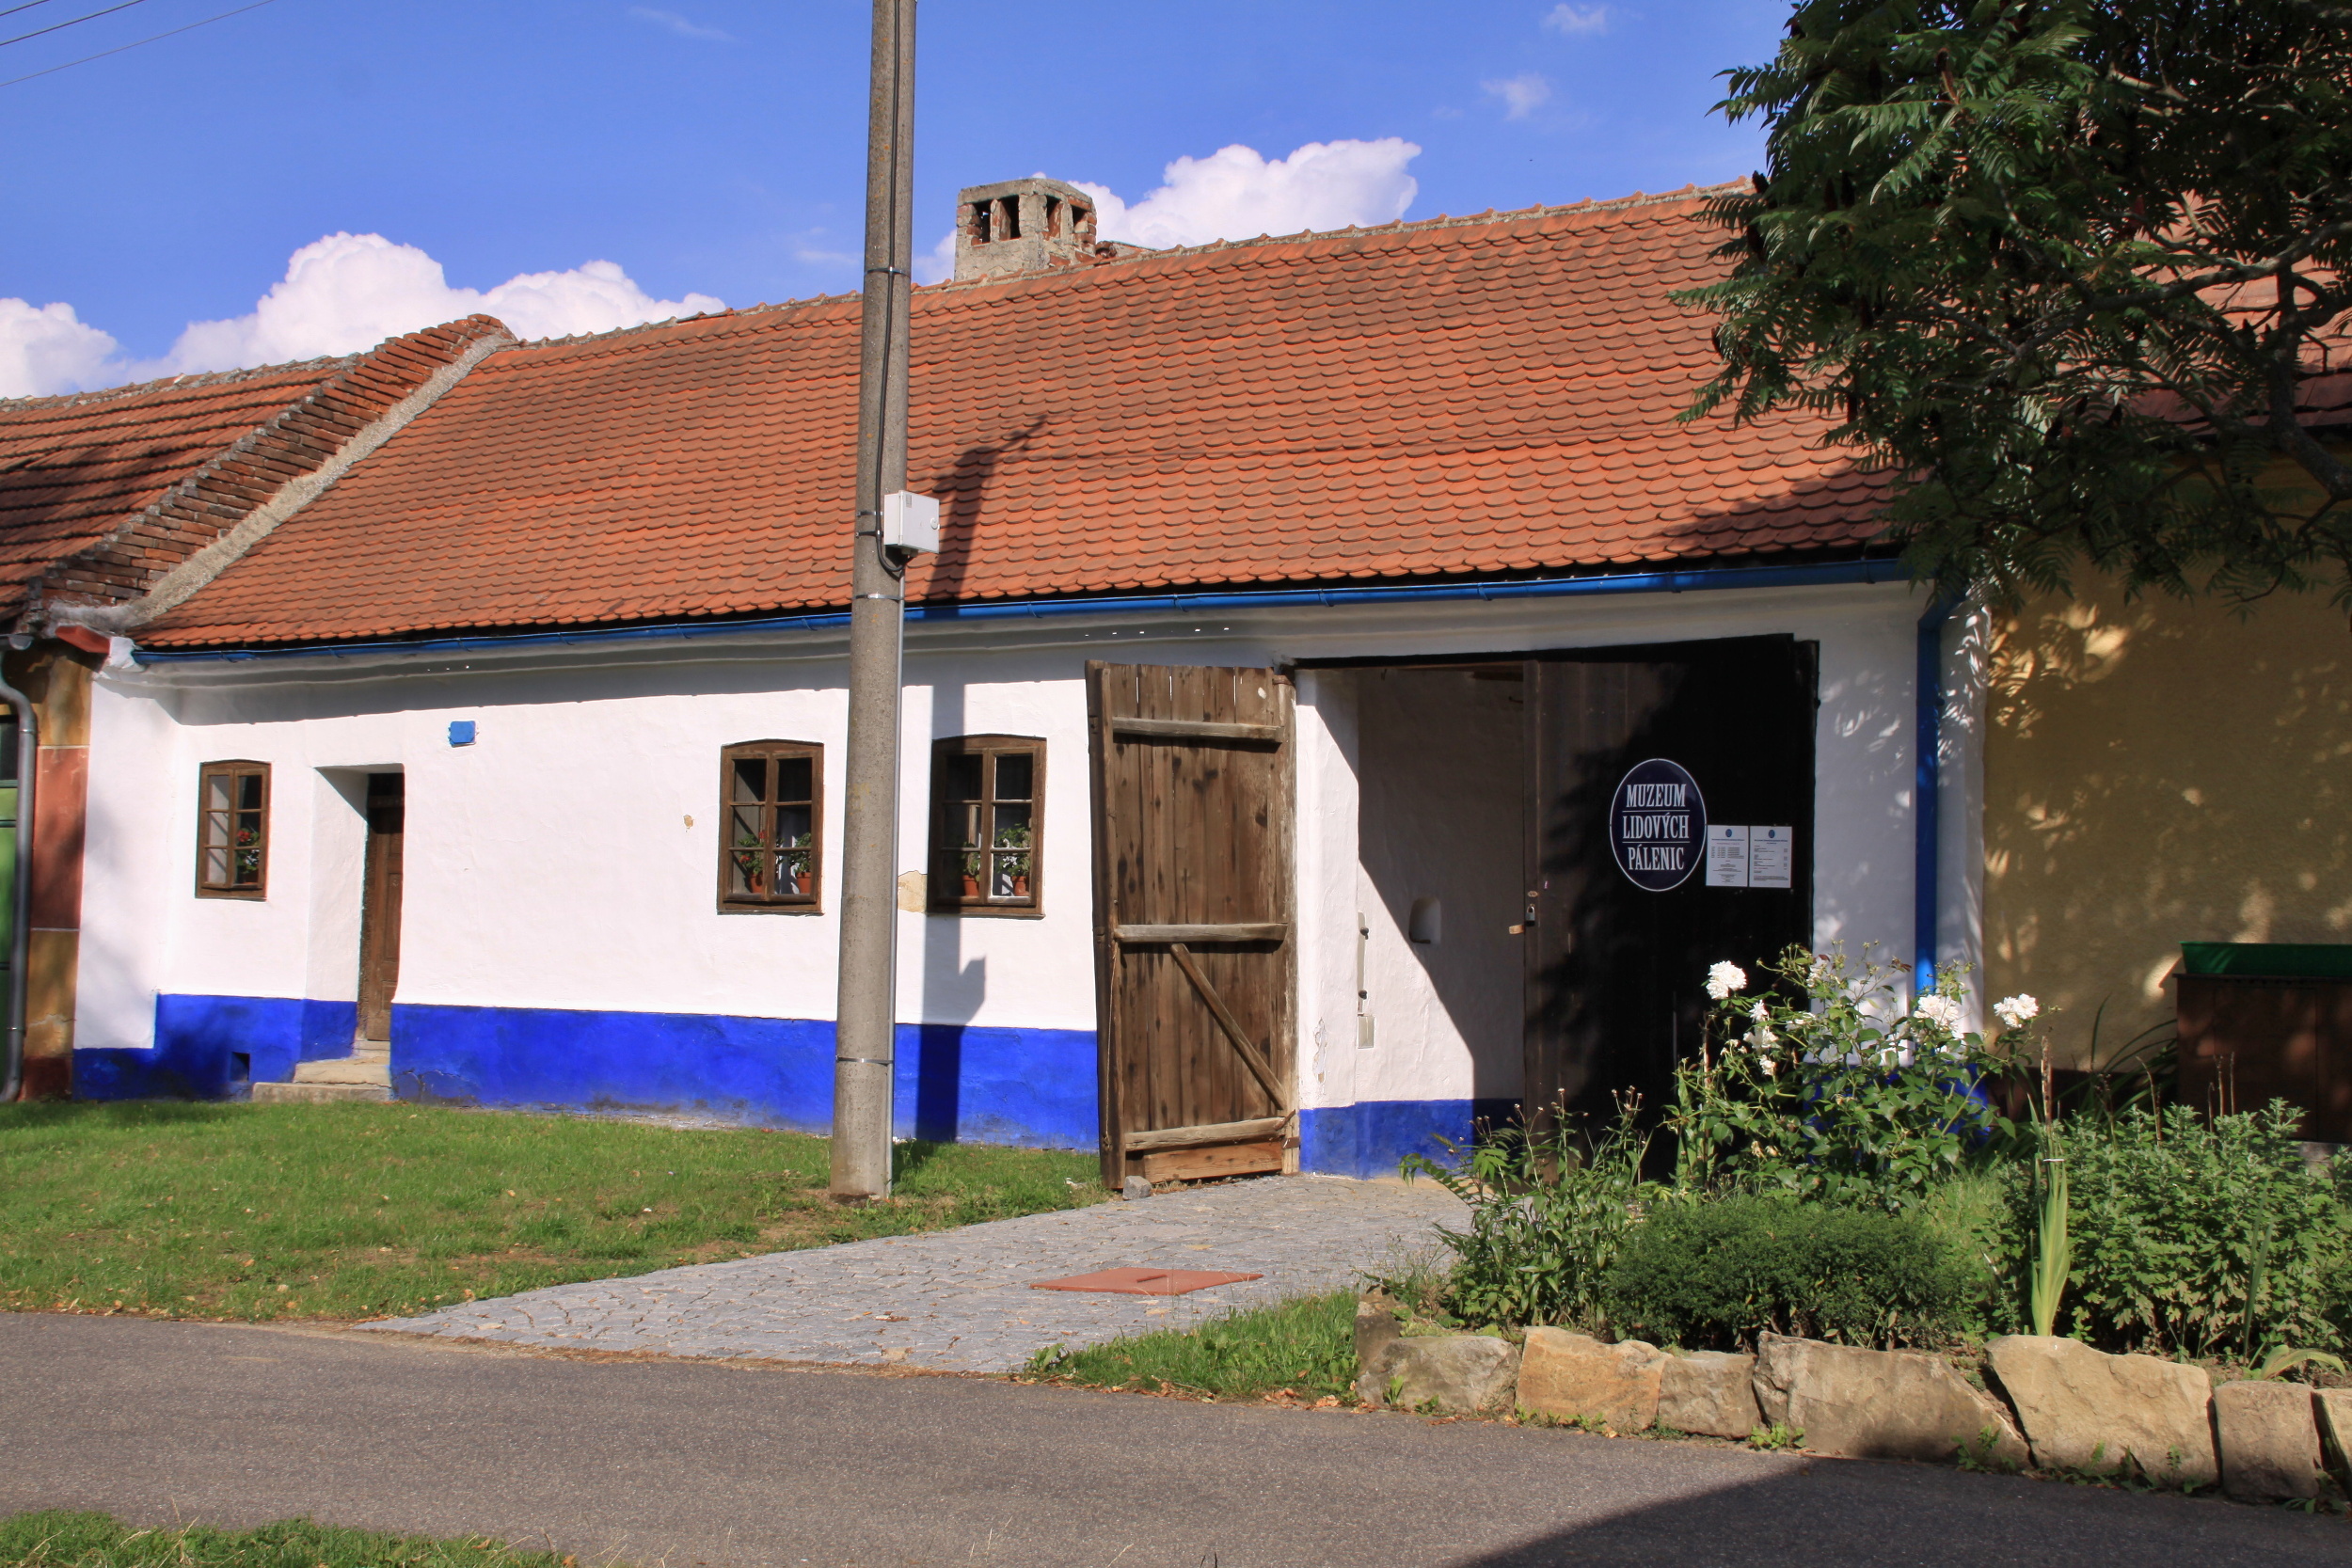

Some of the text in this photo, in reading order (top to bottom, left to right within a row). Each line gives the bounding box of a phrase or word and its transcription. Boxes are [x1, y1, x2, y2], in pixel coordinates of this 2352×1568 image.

[1626, 784, 1687, 808] MUZEUM
[1622, 812, 1690, 839] LIDOVÝCH
[1628, 844, 1685, 871] PÁLENIC
